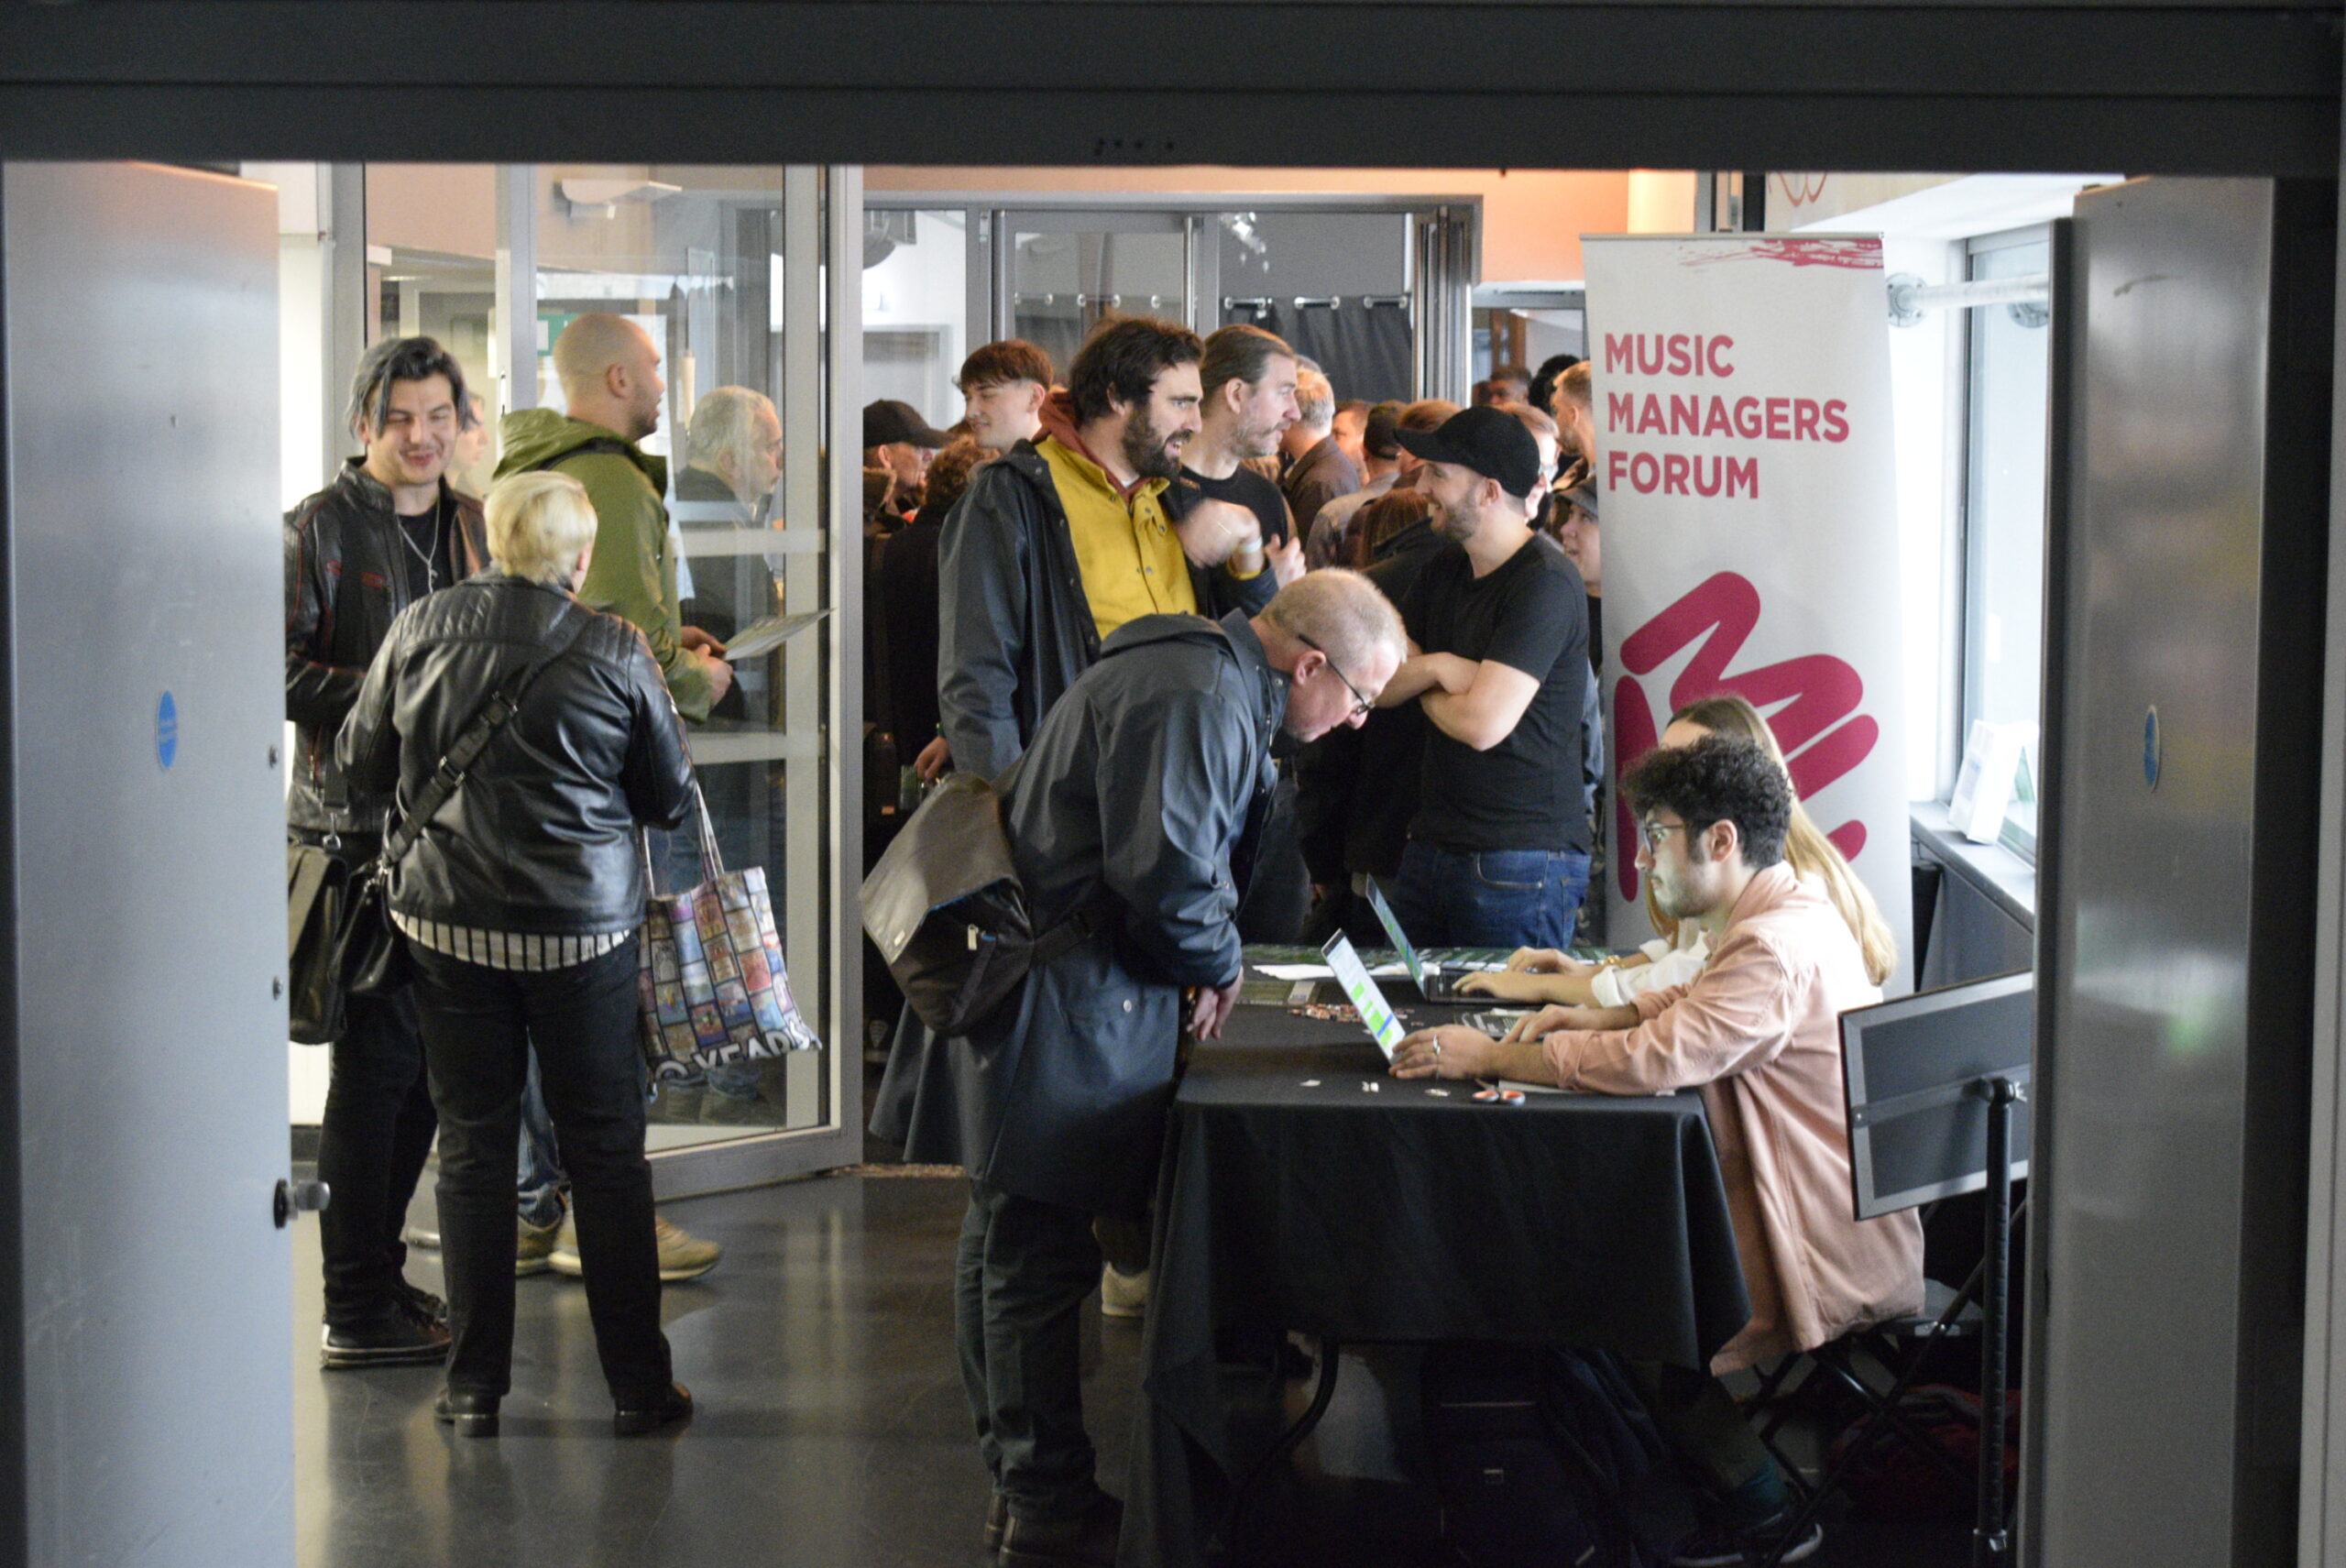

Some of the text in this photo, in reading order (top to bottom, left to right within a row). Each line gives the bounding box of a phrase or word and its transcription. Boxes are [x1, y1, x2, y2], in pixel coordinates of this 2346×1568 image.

[1605, 334, 1735, 378] MUSIC
[1608, 392, 1850, 444] MANAGERS
[1608, 451, 1760, 499] FORUM
